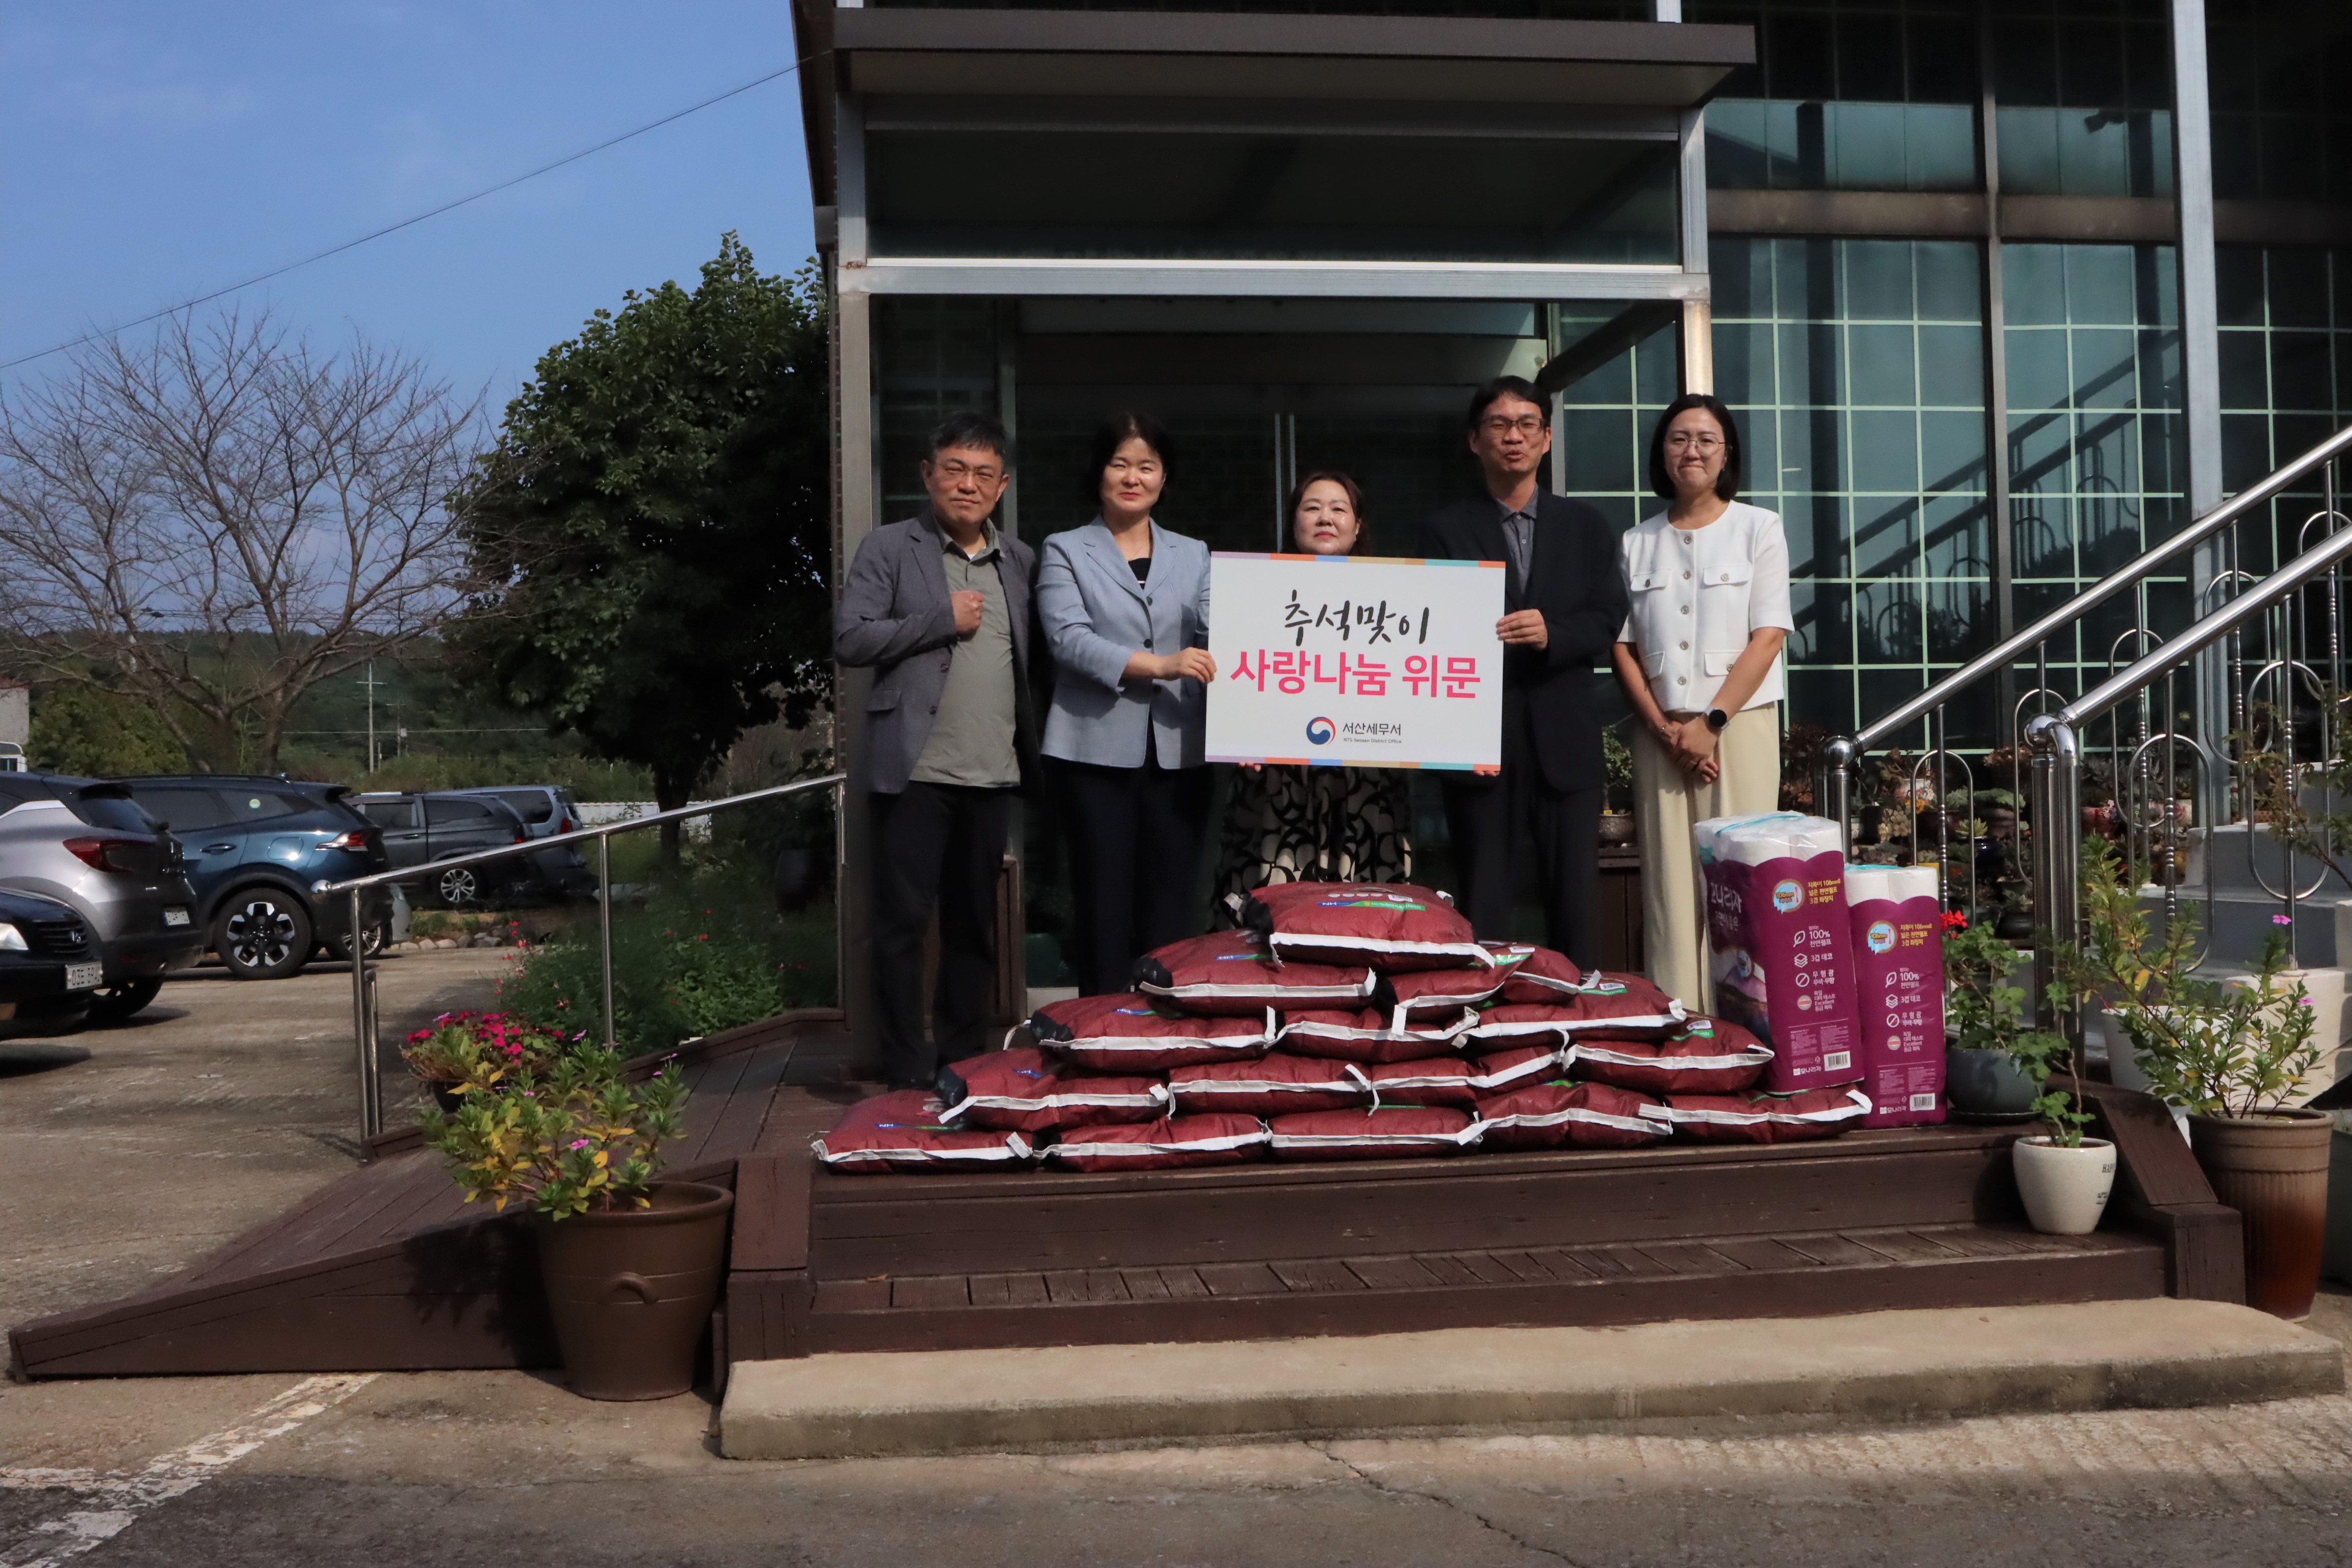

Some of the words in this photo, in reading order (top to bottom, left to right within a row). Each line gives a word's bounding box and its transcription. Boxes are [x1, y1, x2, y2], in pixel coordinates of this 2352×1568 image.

[1285, 589, 1429, 646] 추석맞이
[1230, 649, 1391, 695] 사랑나눔
[1402, 655, 1481, 698] 위문
[1343, 722, 1401, 735] 서산세무서
[1809, 930, 1831, 940] 100%
[1900, 972, 1919, 981] 100%
